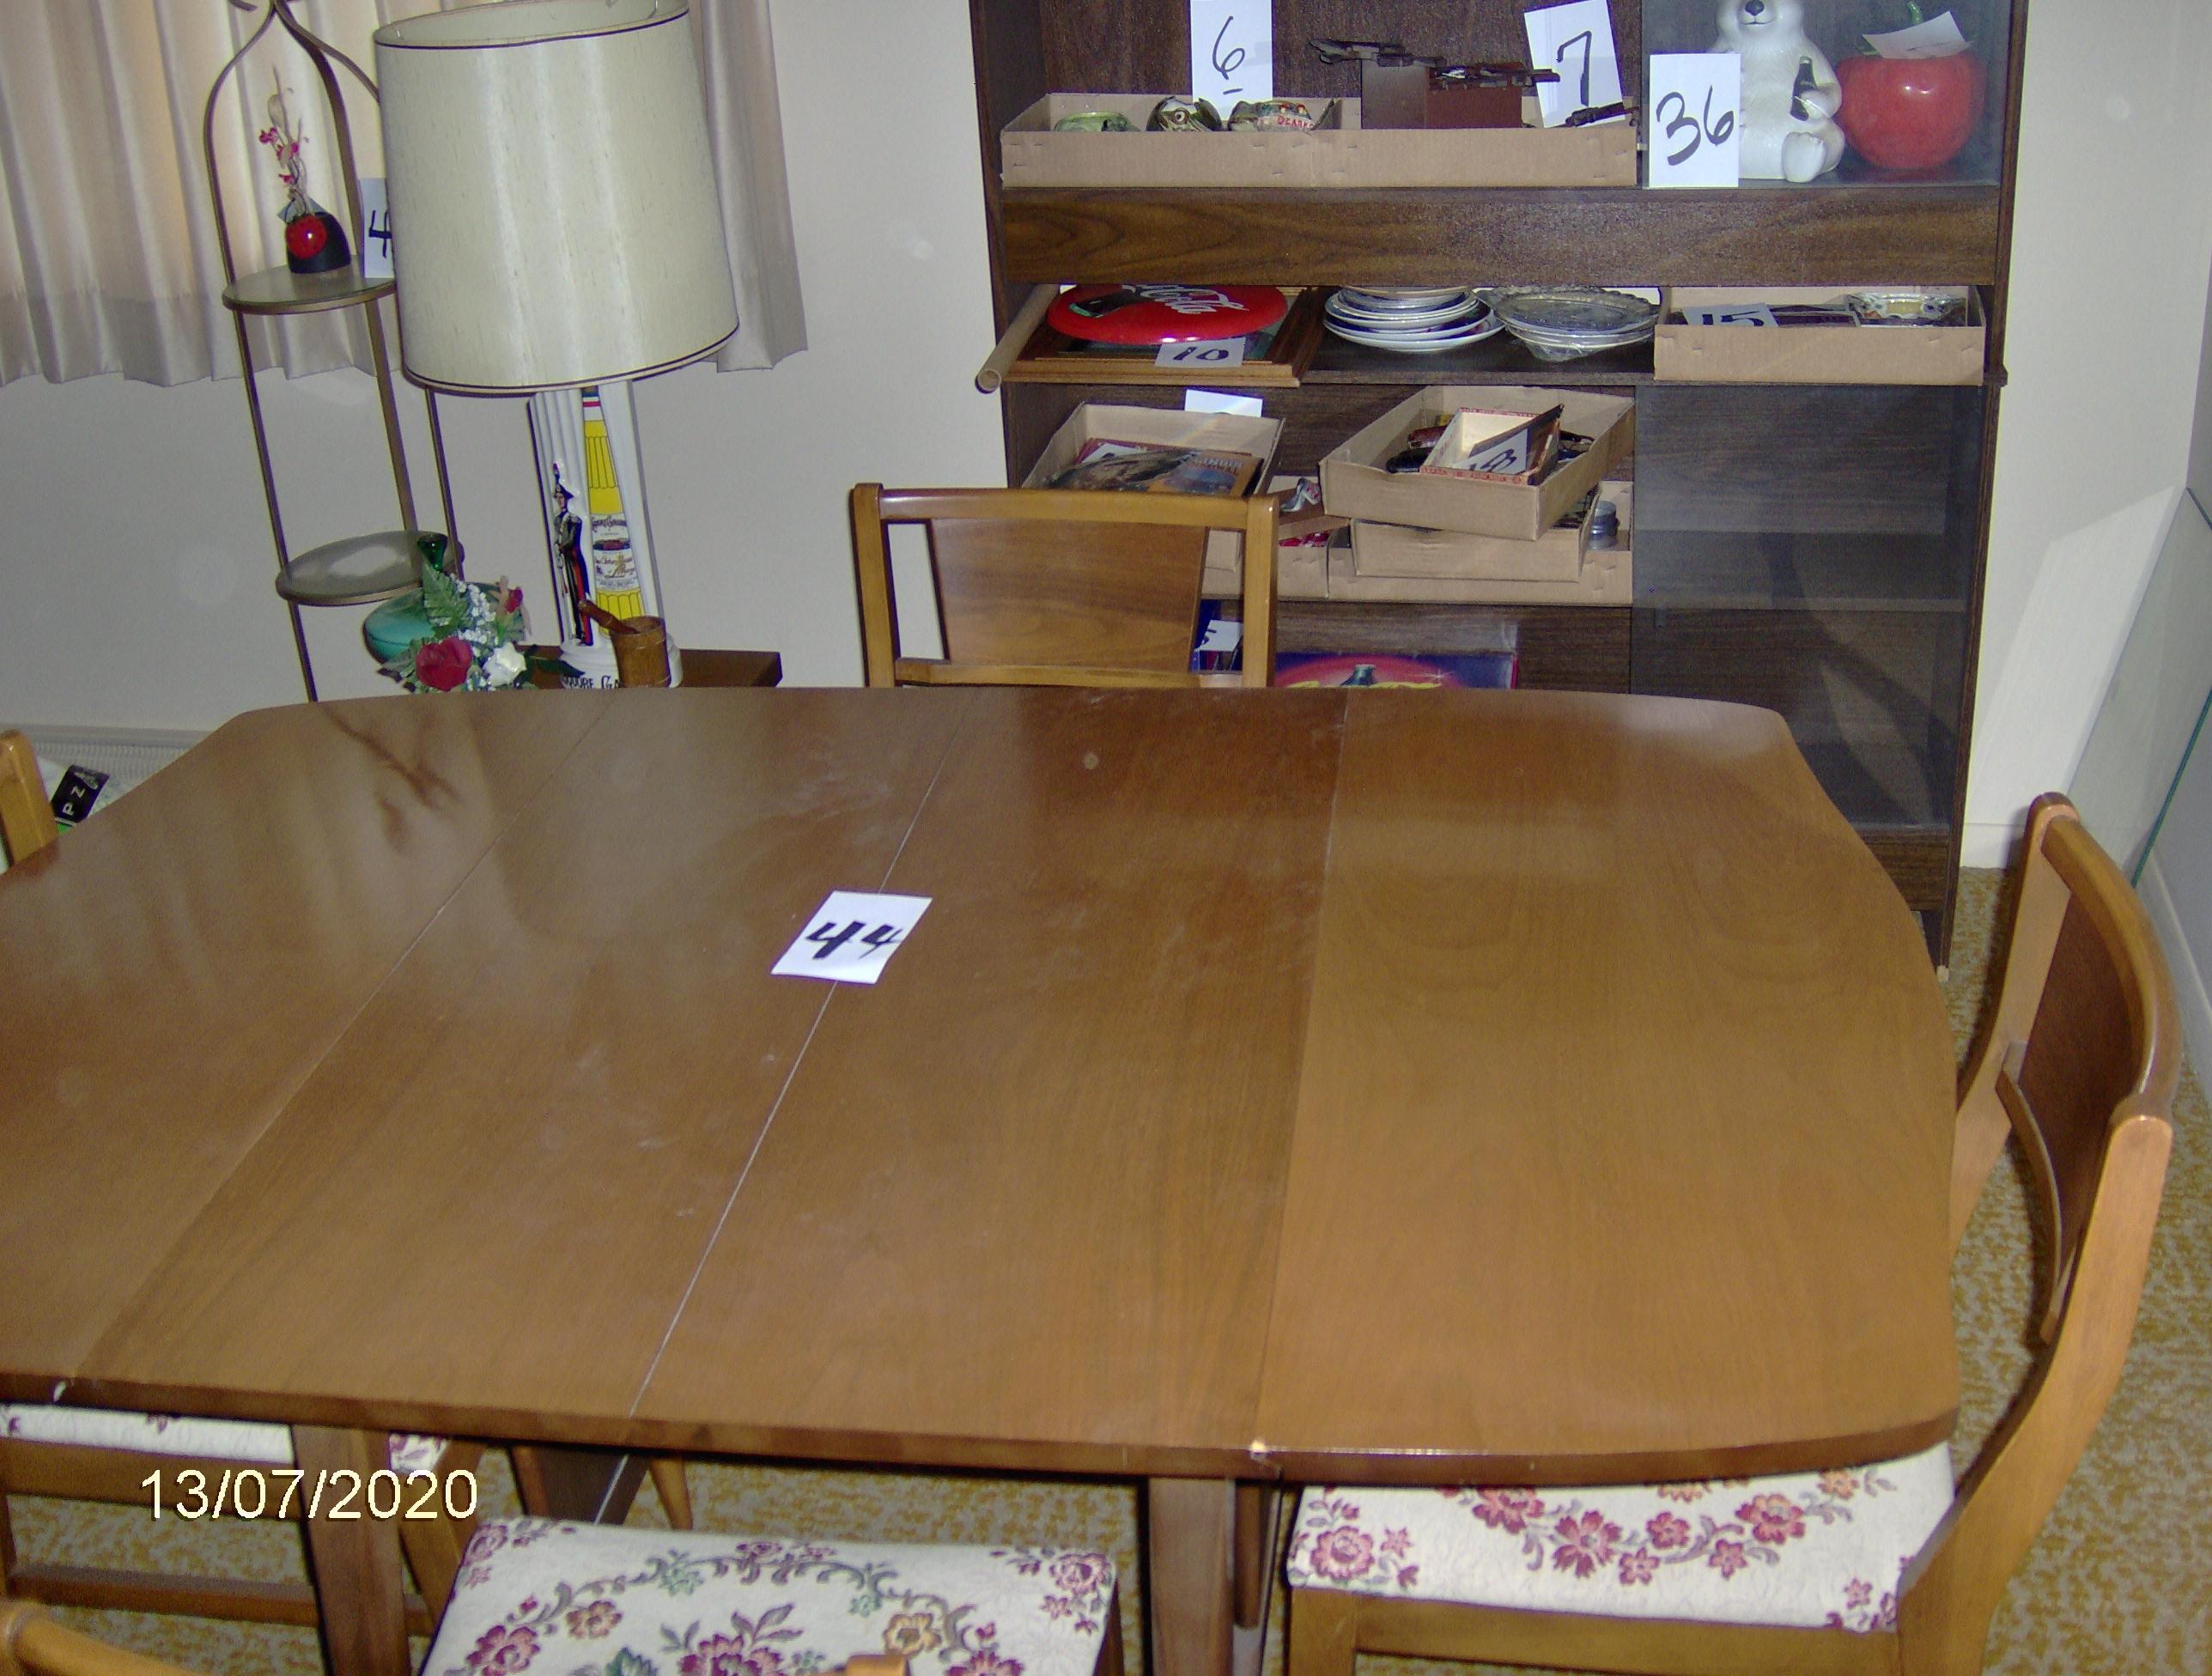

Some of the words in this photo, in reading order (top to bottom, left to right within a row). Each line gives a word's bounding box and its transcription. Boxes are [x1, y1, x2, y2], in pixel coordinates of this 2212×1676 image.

[1212, 15, 1246, 81] 6
[1556, 30, 1591, 106] 7
[1656, 84, 1735, 166] 36
[1173, 346, 1230, 361] 10
[805, 920, 904, 962] 44
